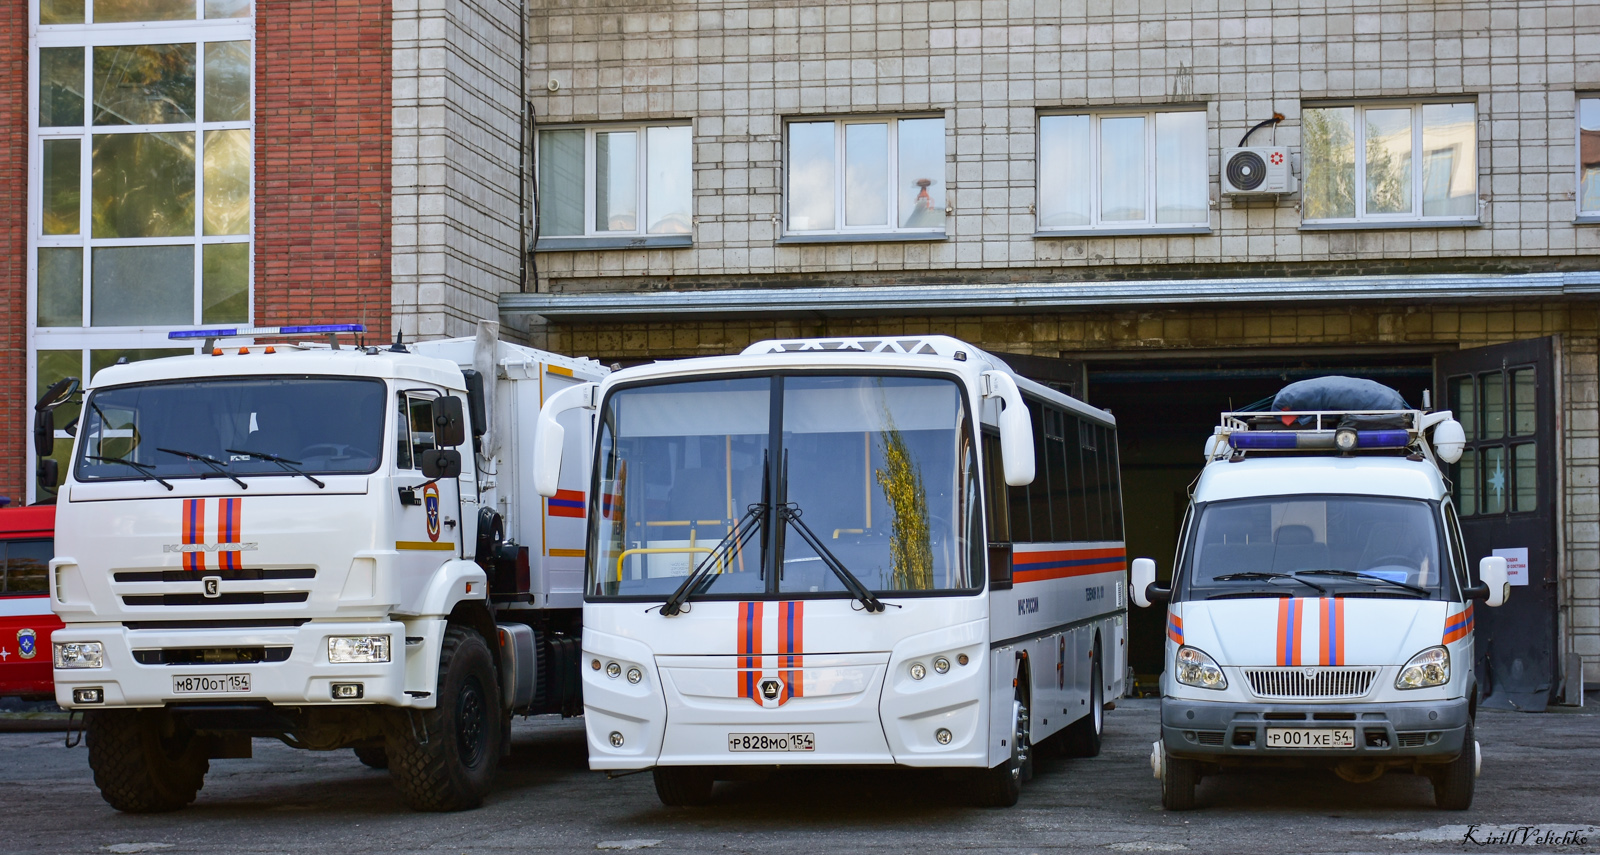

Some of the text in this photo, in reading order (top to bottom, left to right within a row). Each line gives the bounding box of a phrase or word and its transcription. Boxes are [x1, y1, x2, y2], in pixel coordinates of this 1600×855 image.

[163, 542, 258, 553] KAMAZ
[1026, 597, 1039, 614] РОССИИ
[176, 676, 248, 691] М870ОТ 154
[733, 734, 811, 749] Р828МО 154
[1334, 731, 1349, 741] 54
